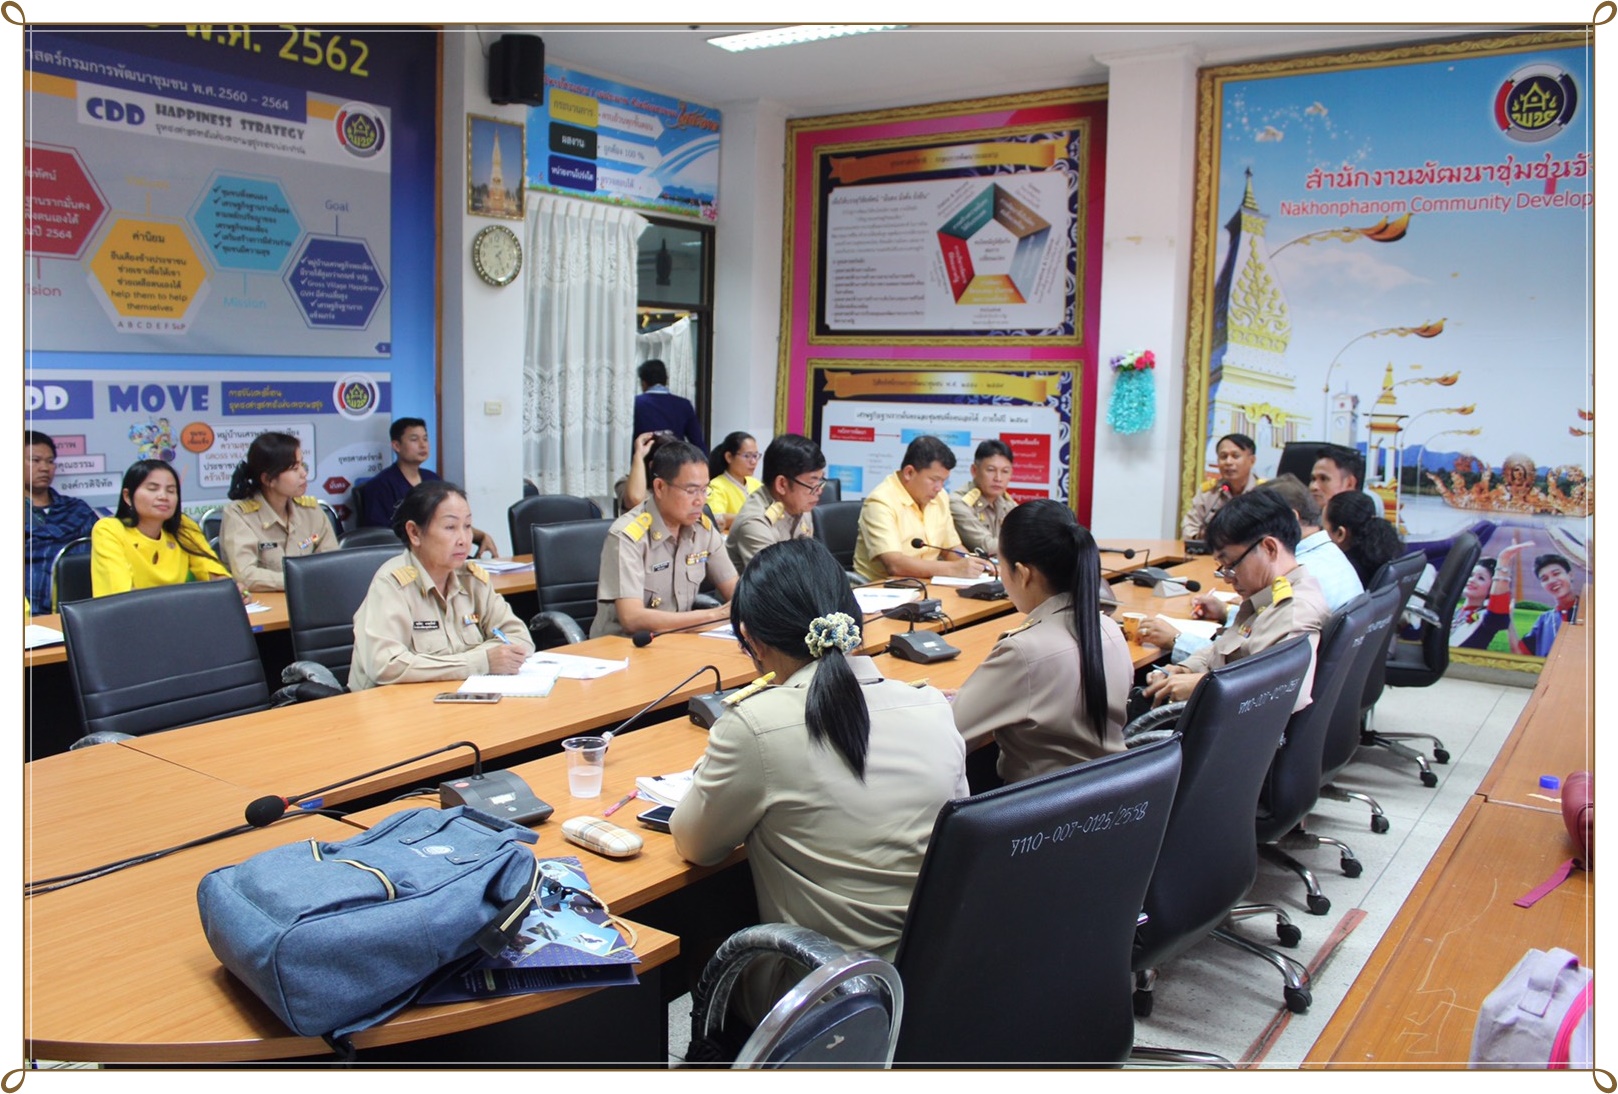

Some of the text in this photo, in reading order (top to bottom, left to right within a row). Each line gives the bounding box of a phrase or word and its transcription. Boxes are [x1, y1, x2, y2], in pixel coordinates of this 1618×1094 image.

[278, 24, 369, 77] 2562
[261, 96, 290, 111] 2564
[86, 97, 305, 141] CDD HAPPINESS STRATEGY
[561, 134, 586, 149] ผลงาน
[1306, 152, 1592, 189] สำนักงานพัฒนาชุมชนจั
[325, 200, 350, 212] Goal
[1280, 190, 1593, 217] Nakhonphanom Community Develop
[46, 228, 73, 240] 2564
[132, 230, 165, 244] ค่านิยม
[25, 284, 62, 297] ision
[111, 289, 131, 299] help
[133, 291, 156, 300] them
[168, 293, 188, 302] help
[126, 302, 174, 312] themselves
[108, 384, 209, 412] MOVE
